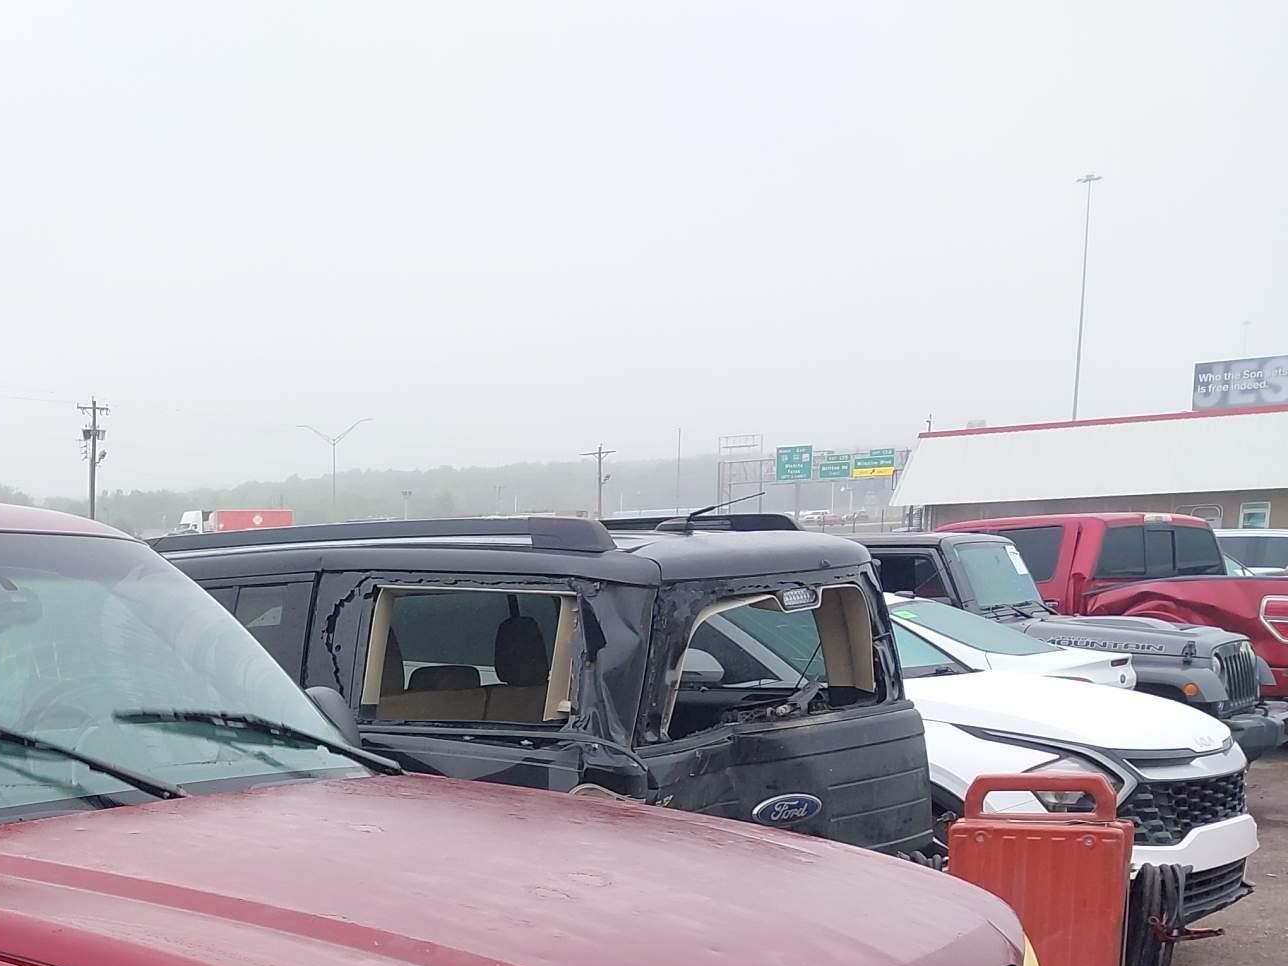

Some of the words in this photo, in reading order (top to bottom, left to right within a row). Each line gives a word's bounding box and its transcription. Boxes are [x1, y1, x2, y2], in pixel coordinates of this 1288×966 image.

[1198, 373, 1221, 383] Who
[1242, 369, 1263, 379] Son
[770, 800, 809, 821] Ford
